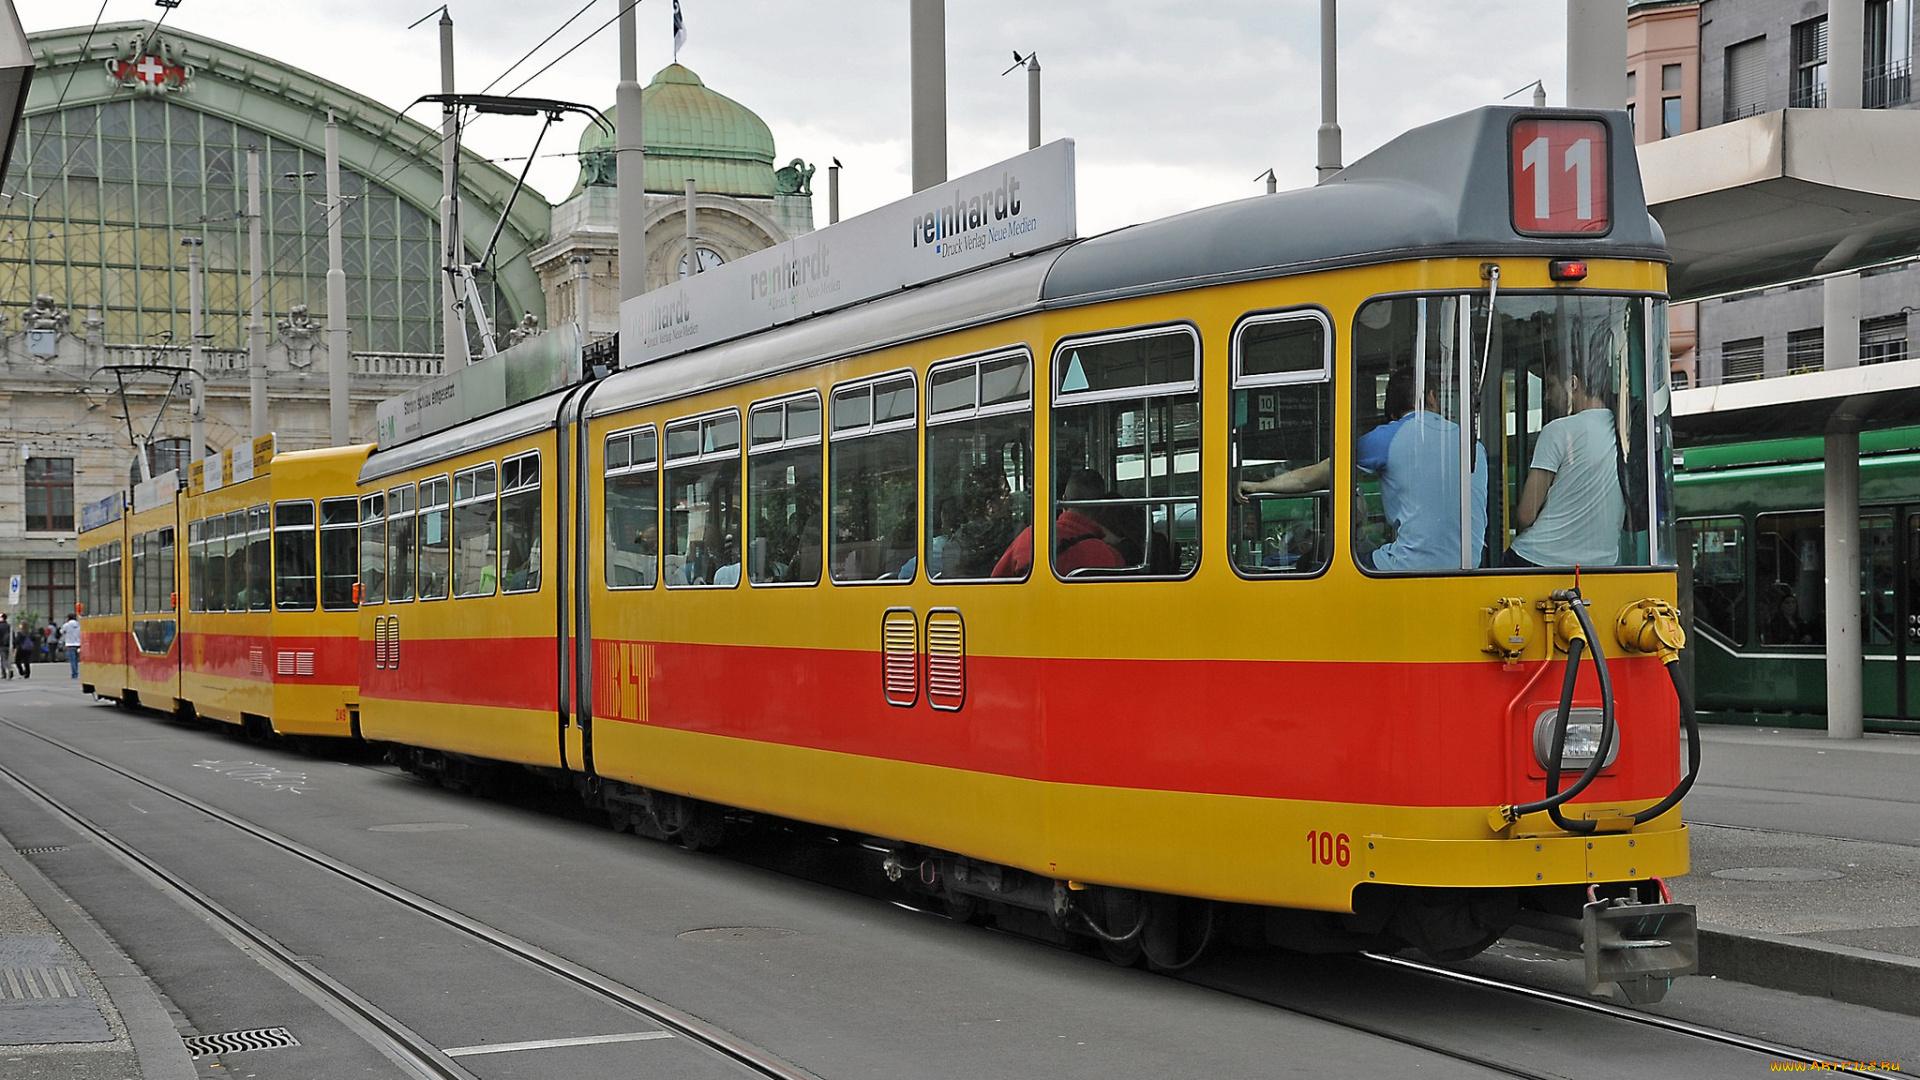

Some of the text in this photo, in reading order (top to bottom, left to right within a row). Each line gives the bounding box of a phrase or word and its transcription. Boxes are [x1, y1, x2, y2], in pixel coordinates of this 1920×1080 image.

[1522, 137, 1592, 219] 11
[913, 171, 1021, 248] reinhardt
[942, 217, 1036, 258] Druck Verlag Neue Medien
[750, 240, 830, 301] reinhardt
[179, 382, 193, 396] 15
[1261, 397, 1273, 410] 10
[1261, 420, 1271, 430] 11
[1306, 829, 1351, 867] 106
